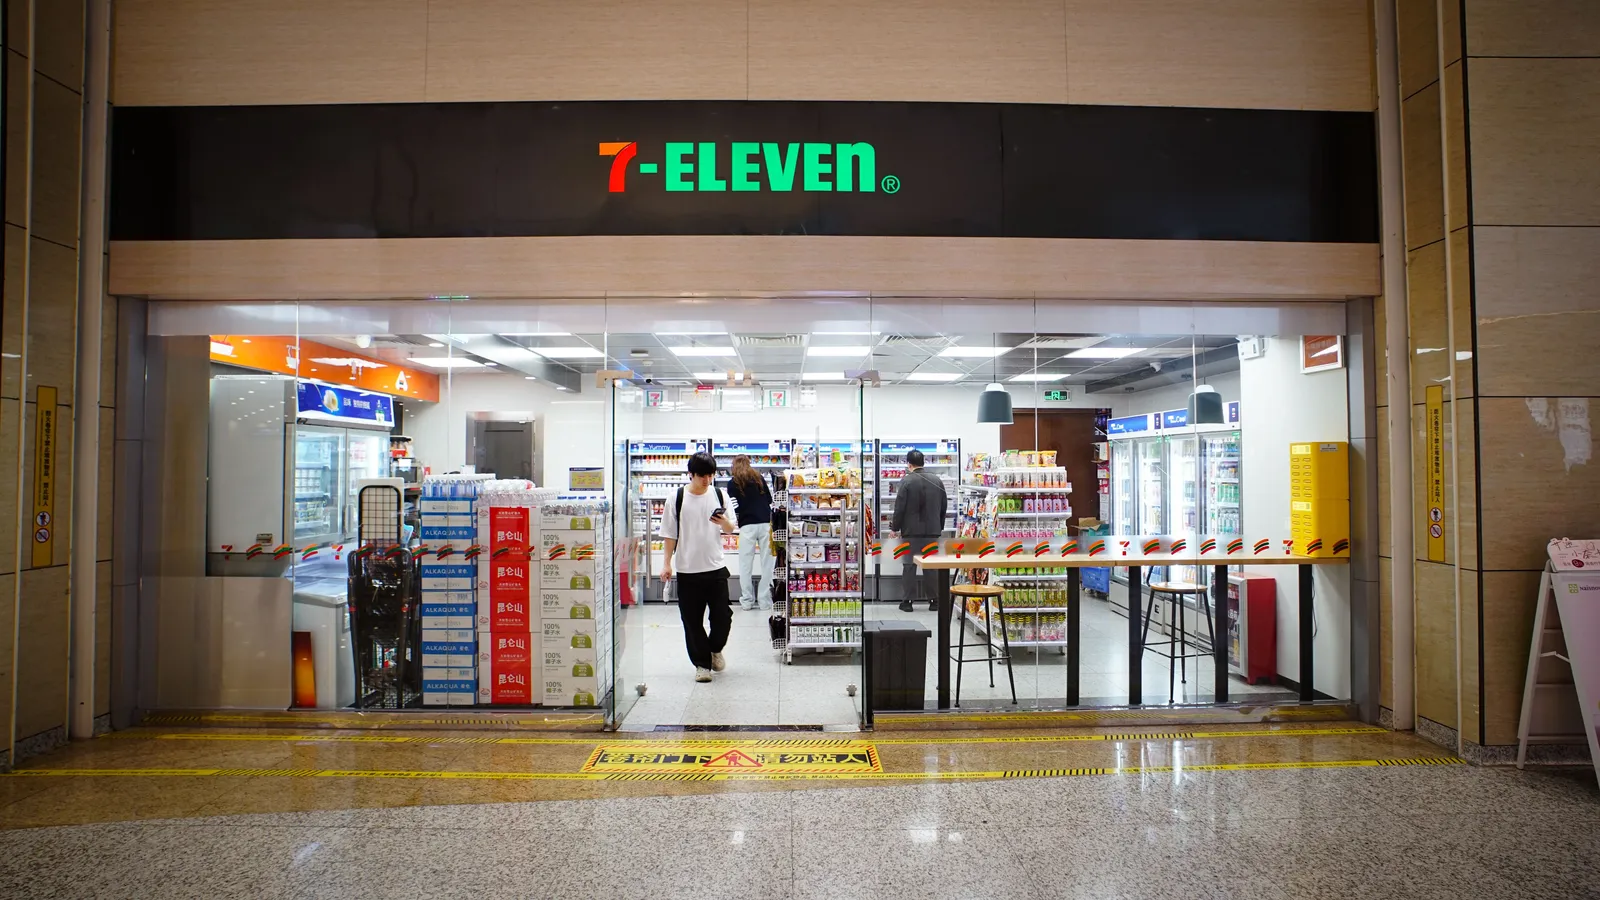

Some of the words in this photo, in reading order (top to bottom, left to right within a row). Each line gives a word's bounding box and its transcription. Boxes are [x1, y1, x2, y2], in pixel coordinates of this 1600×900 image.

[497, 531, 523, 542] 昆仑山
[498, 566, 524, 578] 昆仑山
[497, 603, 524, 614] 昆仑山
[498, 638, 525, 650] 昆仑山
[498, 674, 525, 685] 昆仑山
